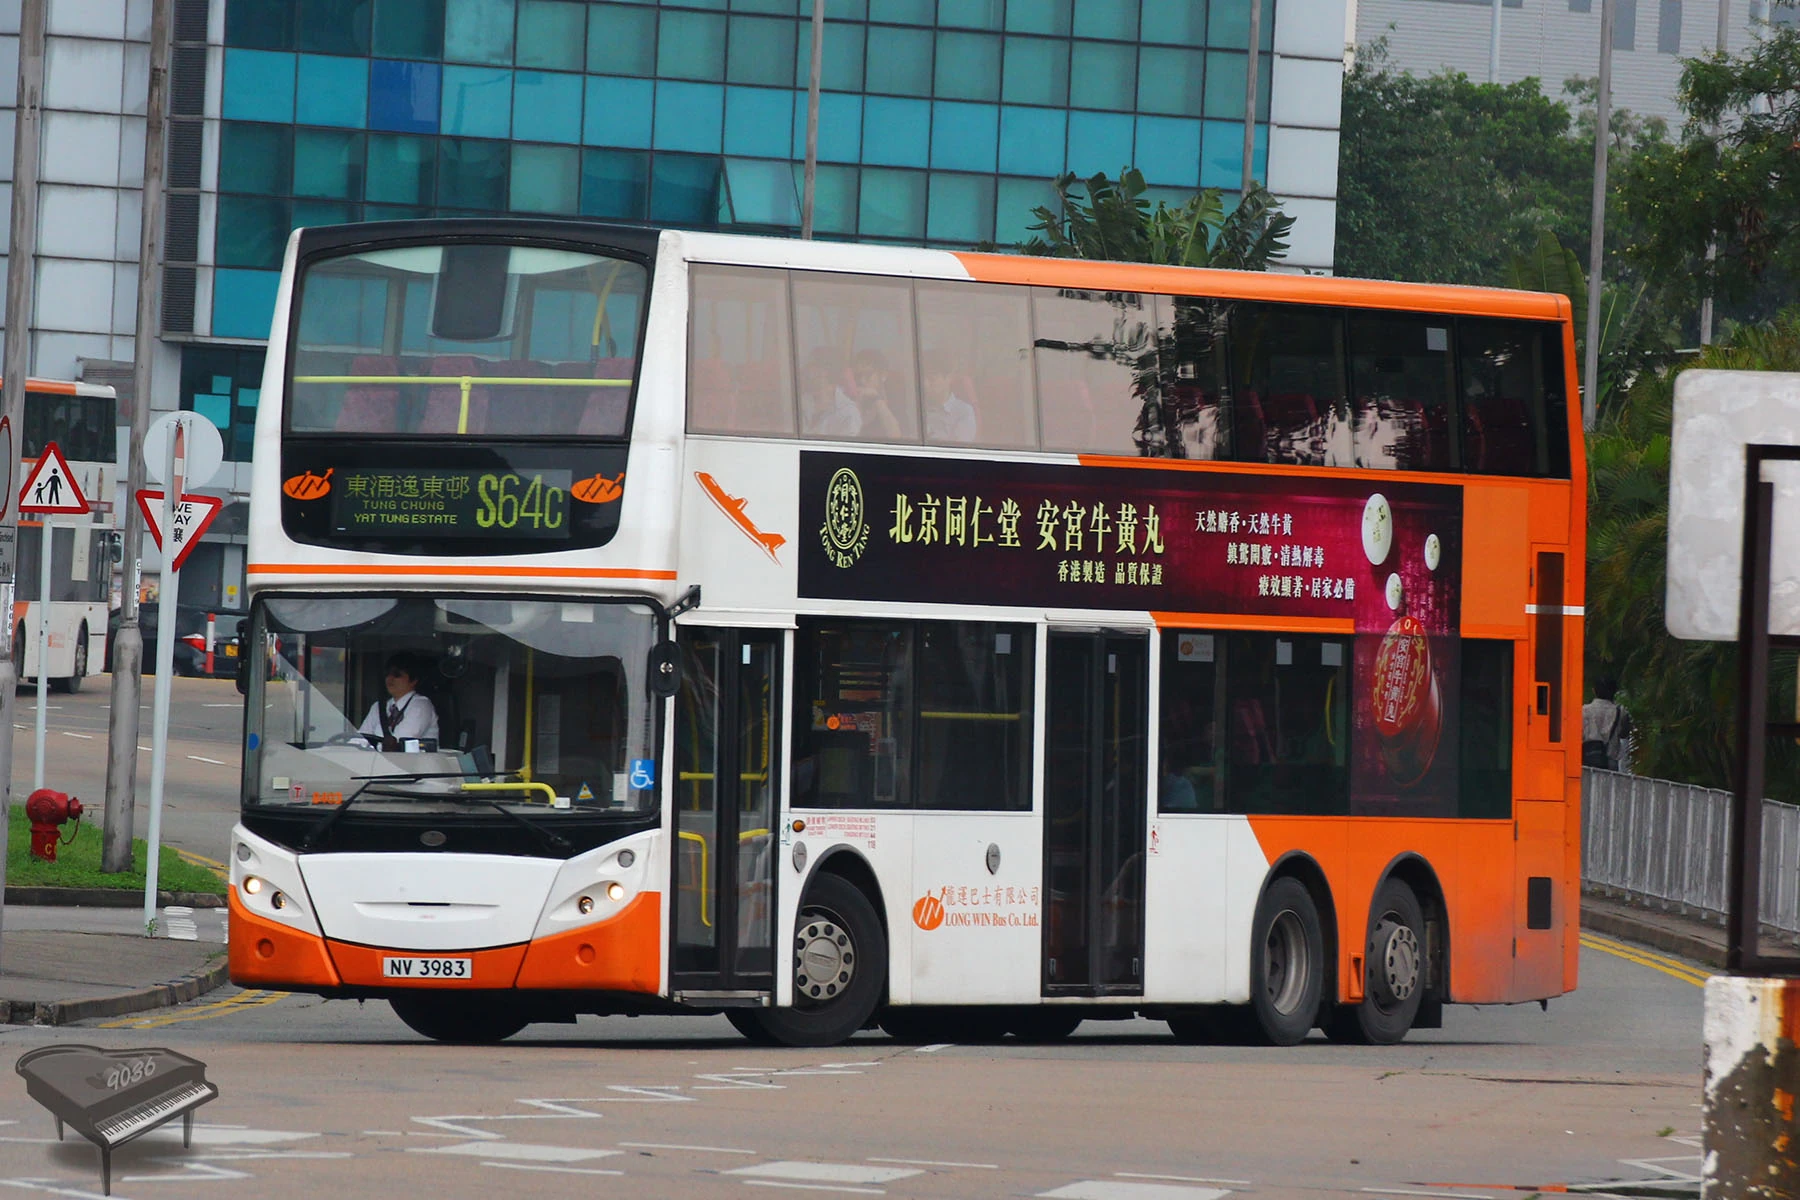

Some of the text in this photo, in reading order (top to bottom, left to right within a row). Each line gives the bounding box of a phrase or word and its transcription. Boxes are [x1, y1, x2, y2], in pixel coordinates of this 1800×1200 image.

[344, 474, 471, 500] 東涌逸東邨
[363, 500, 445, 511] TUNG CHUNG
[174, 514, 191, 525] AY
[354, 513, 457, 524] YAT TUNG ESTATE
[889, 493, 1165, 556] 北京同仁堂 安宮牛黃丸
[835, 551, 854, 569] REN
[1057, 560, 1106, 584] 香港製造
[945, 885, 1039, 907] 龍運巴士有限公司
[945, 912, 970, 927] LONG
[972, 912, 991, 927] WIN
[992, 912, 1007, 927] Bus
[1023, 912, 1039, 927] Ltd.
[391, 959, 465, 977] NV 3983
